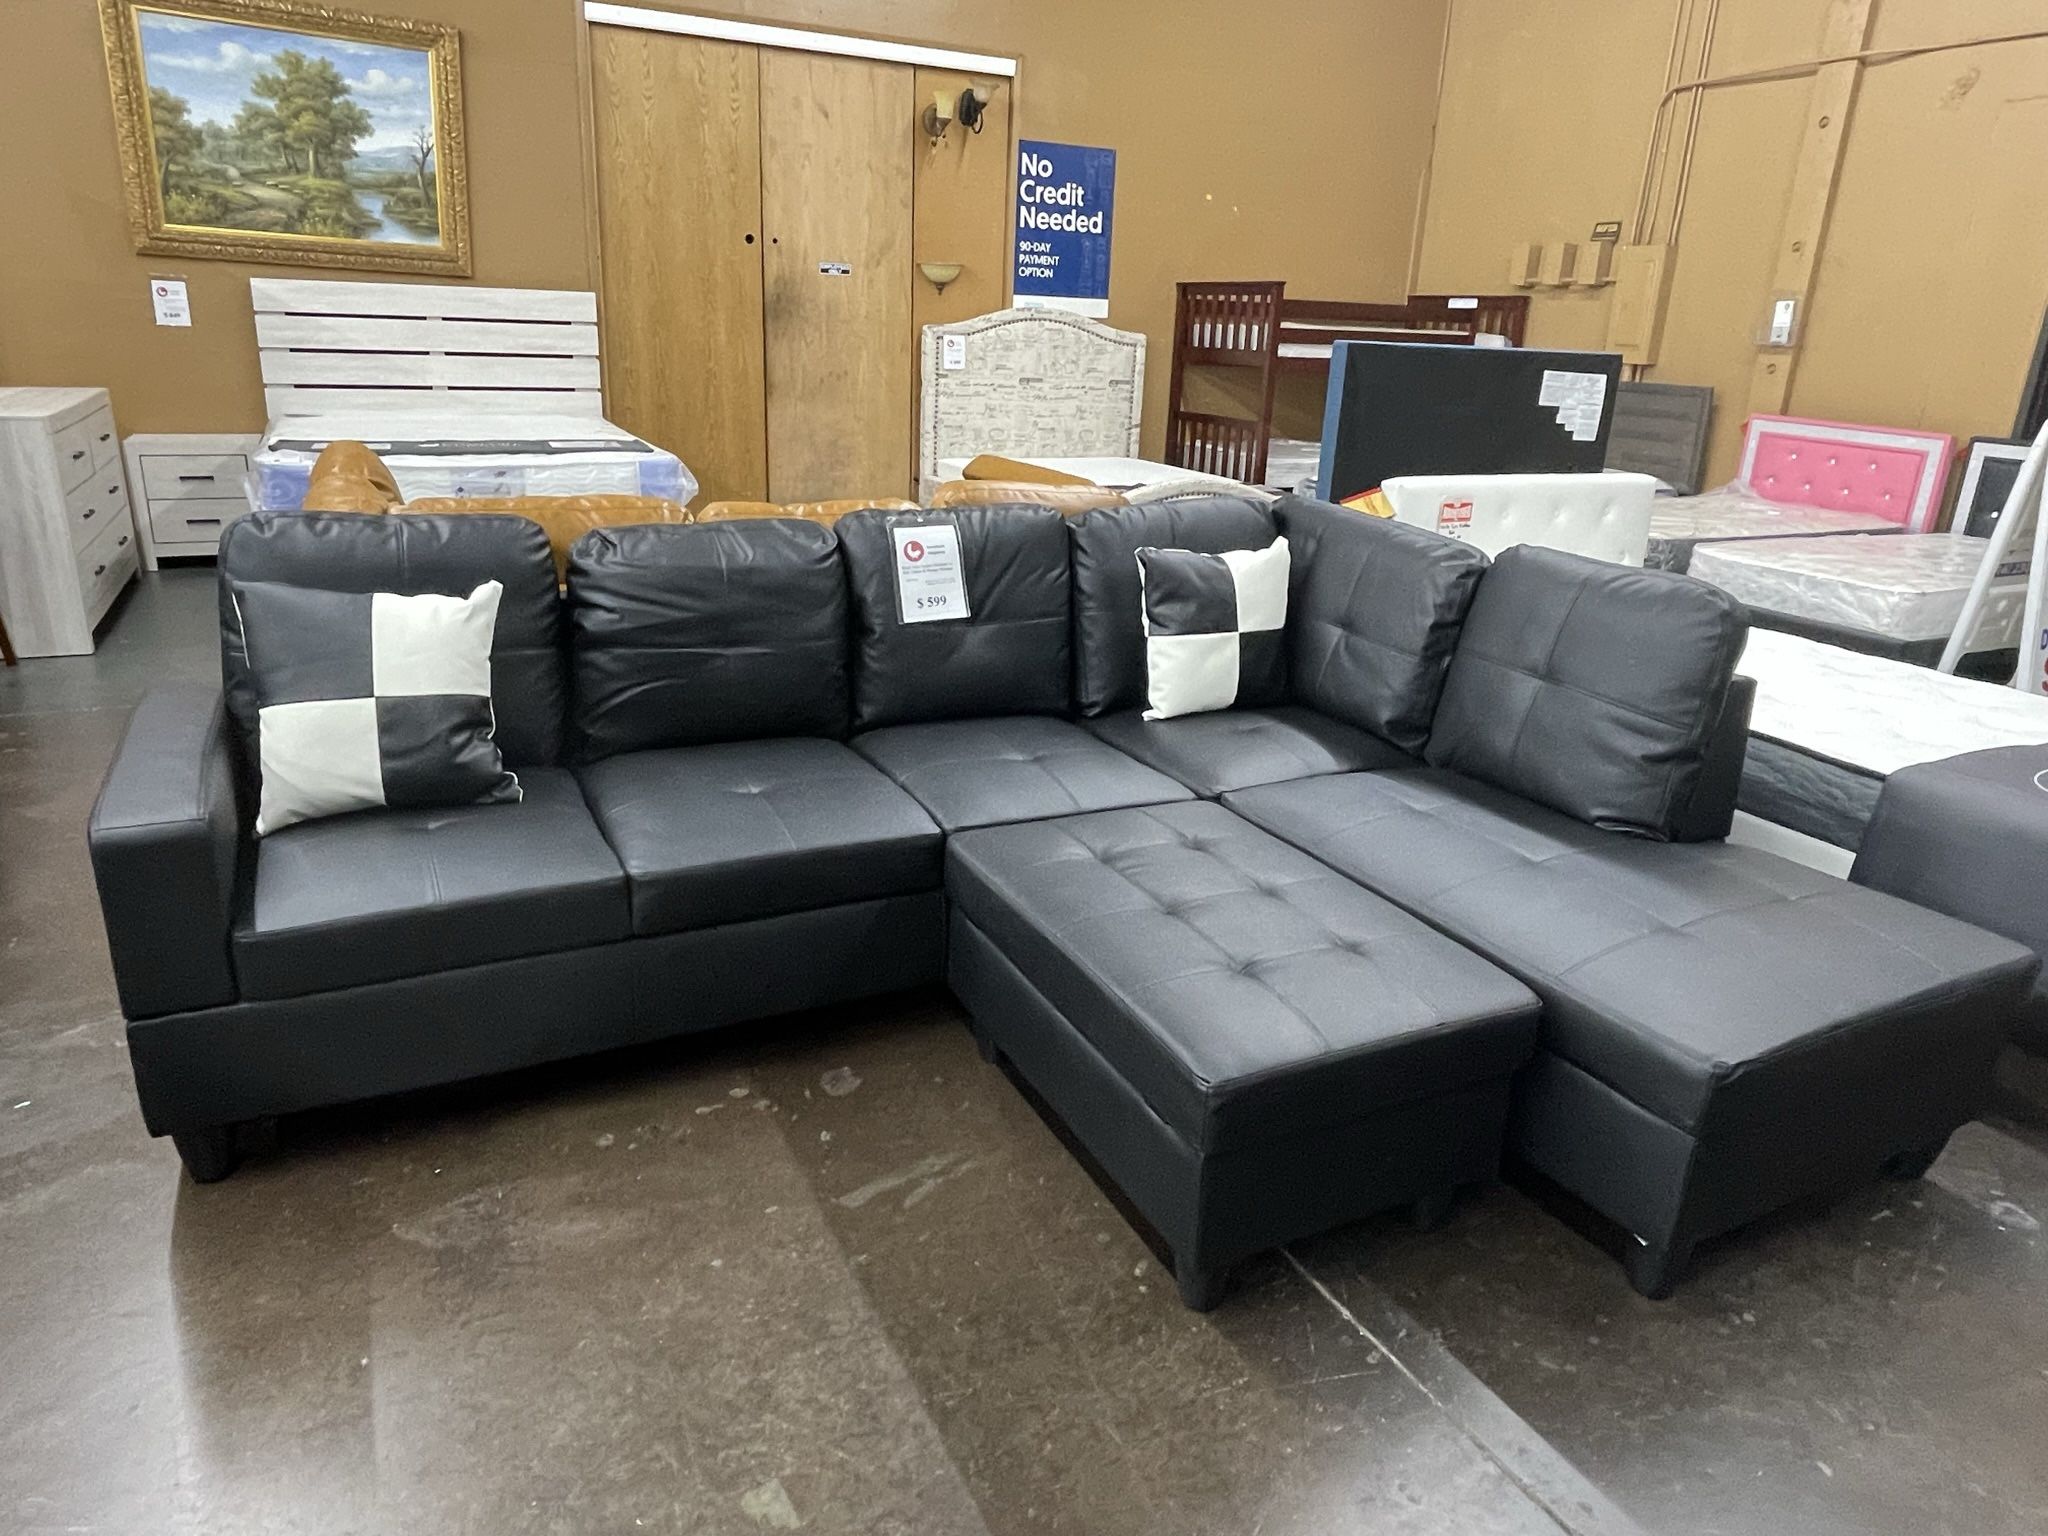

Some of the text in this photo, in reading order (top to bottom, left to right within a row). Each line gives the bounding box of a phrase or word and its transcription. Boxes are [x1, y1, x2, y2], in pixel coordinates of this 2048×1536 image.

[1021, 152, 1053, 178] No
[1019, 179, 1085, 207] Credit
[1019, 206, 1103, 234] Needed
[1019, 241, 1052, 253] 90-DAY
[1018, 254, 1060, 266] PAYMENT
[1018, 267, 1054, 279] OPTION
[917, 595, 947, 609] $ 599
